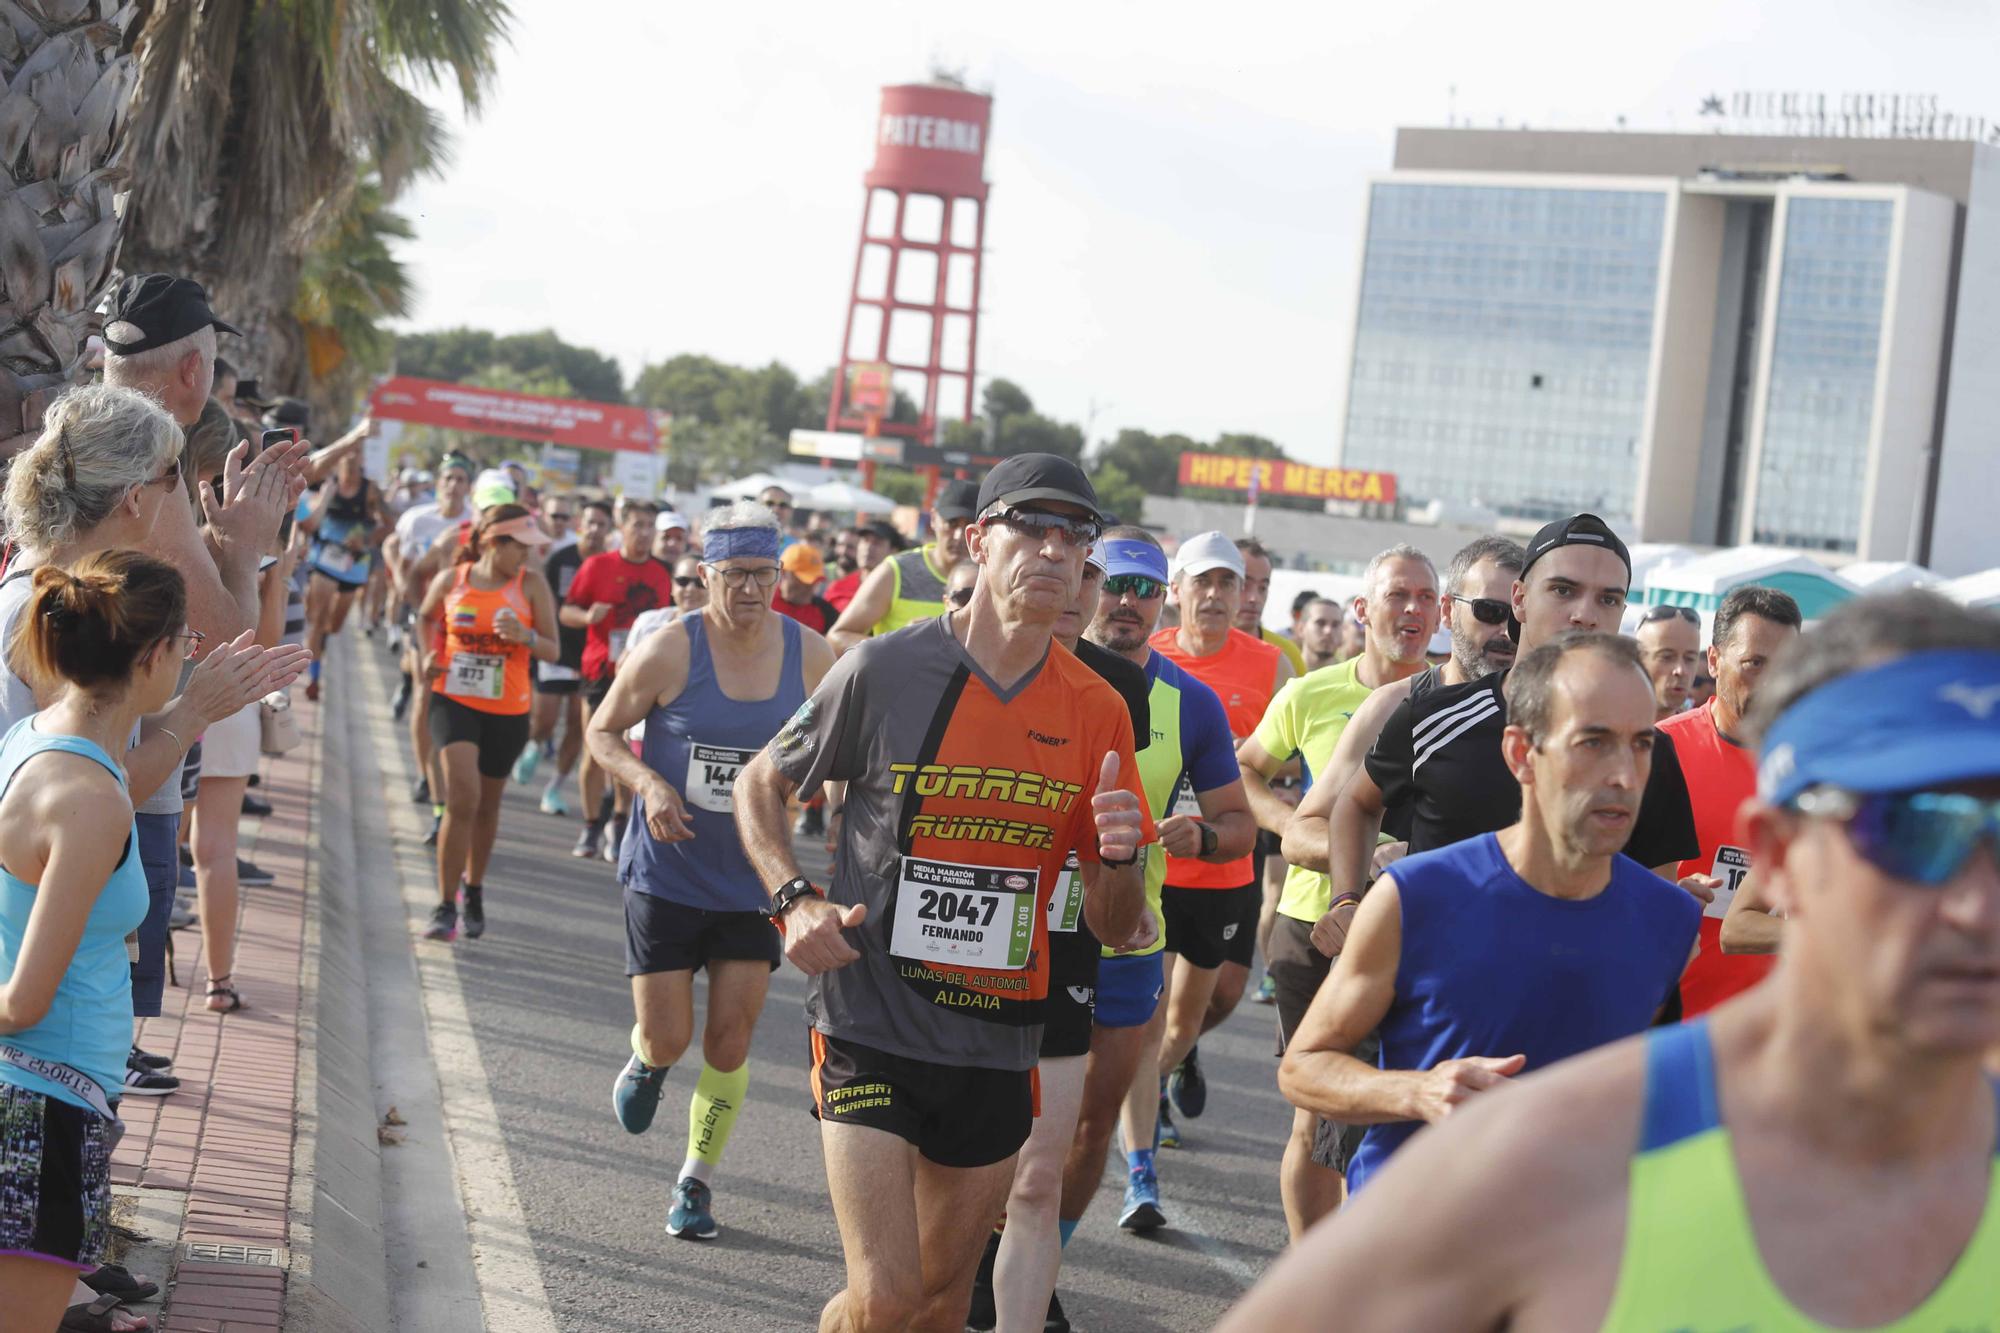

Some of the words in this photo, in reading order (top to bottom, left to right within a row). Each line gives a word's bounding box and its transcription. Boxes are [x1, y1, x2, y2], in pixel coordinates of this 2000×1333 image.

[879, 114, 980, 154] PATERNA
[1190, 454, 1273, 490] HIPER
[1283, 463, 1382, 500] MERCA
[889, 763, 1084, 814] TORRENT
[913, 864, 935, 875] MEDIA
[937, 867, 975, 879] MARATÓN
[913, 871, 930, 881] VILA
[931, 874, 941, 883] DE
[942, 876, 975, 887] PATERNA
[917, 889, 999, 927] 2047
[1017, 906, 1029, 927] BOX
[921, 924, 984, 943] FERNANDO
[1016, 930, 1027, 938] 3
[901, 964, 944, 982] LUNAS
[946, 972, 969, 986] DEL
[934, 990, 1001, 1010] ALDAIA
[826, 1084, 892, 1103] TORRENT
[834, 1097, 892, 1115] RUNNERS
